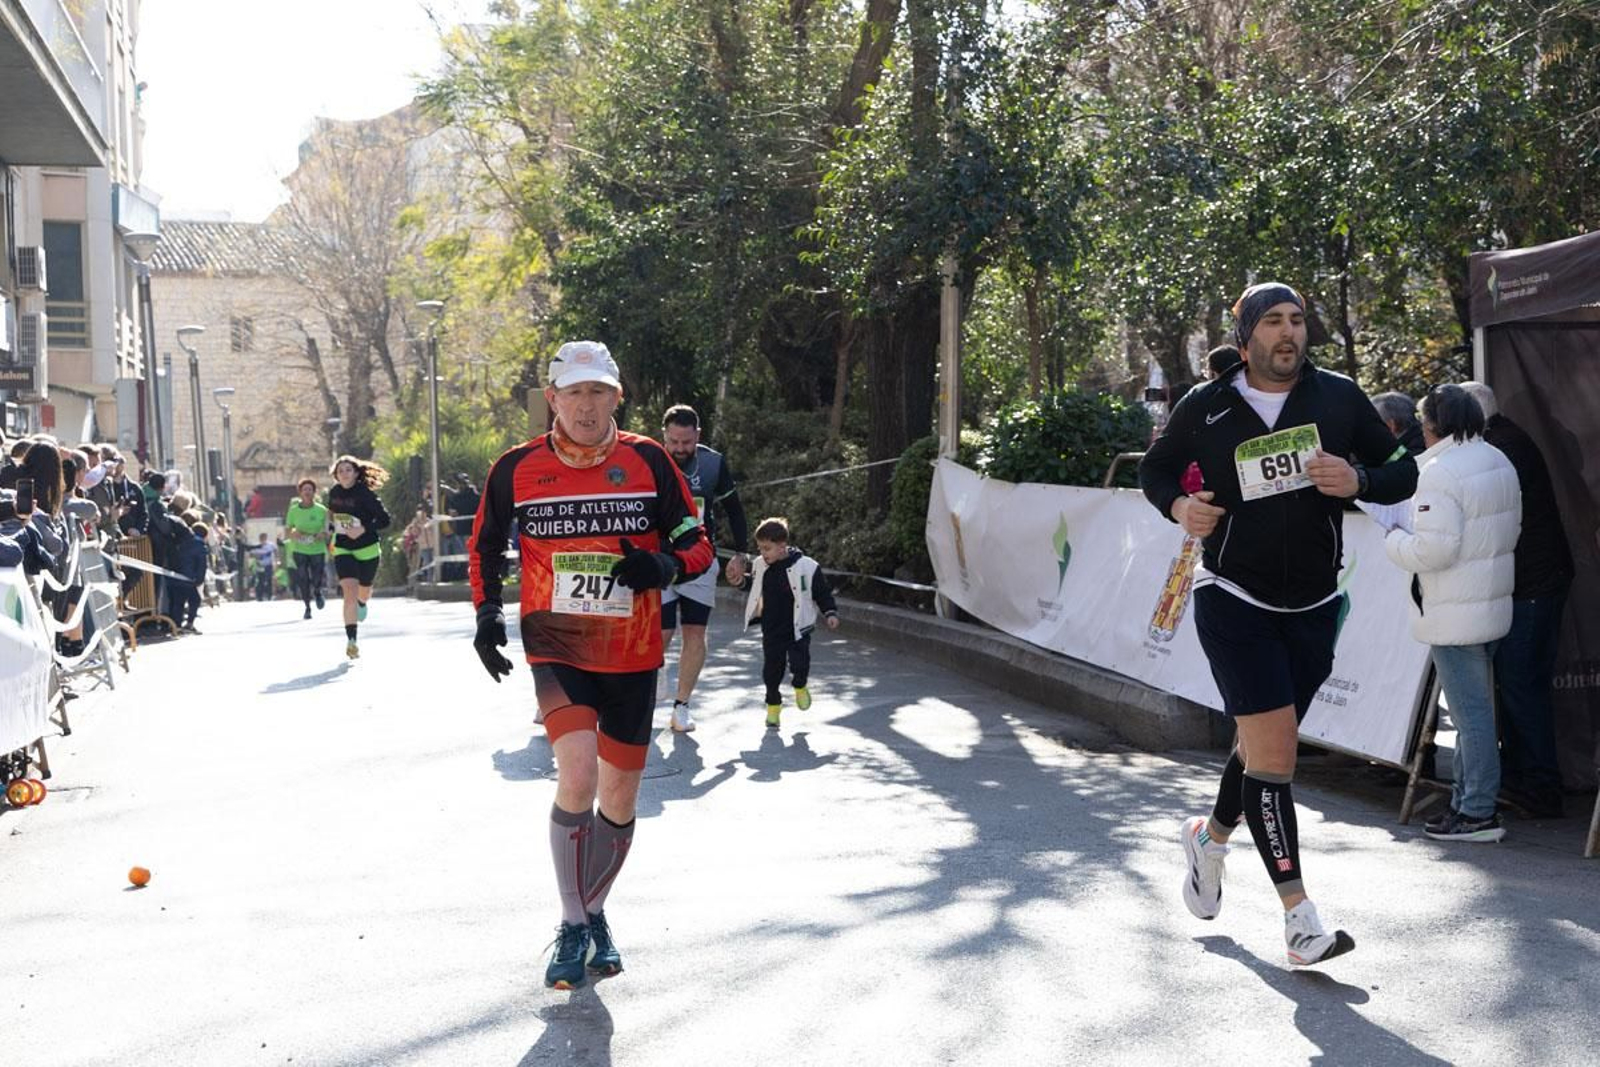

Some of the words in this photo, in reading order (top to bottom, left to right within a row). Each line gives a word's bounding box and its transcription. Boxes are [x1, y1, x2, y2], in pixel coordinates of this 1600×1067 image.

[1260, 451, 1302, 480] 691
[527, 505, 554, 517] CLUB
[559, 504, 575, 516] DE
[580, 500, 644, 515] ATLETISMO
[525, 517, 649, 536] QUIEBRAJANO
[570, 574, 616, 600] 247
[1260, 789, 1284, 859] COMPRESPORT
